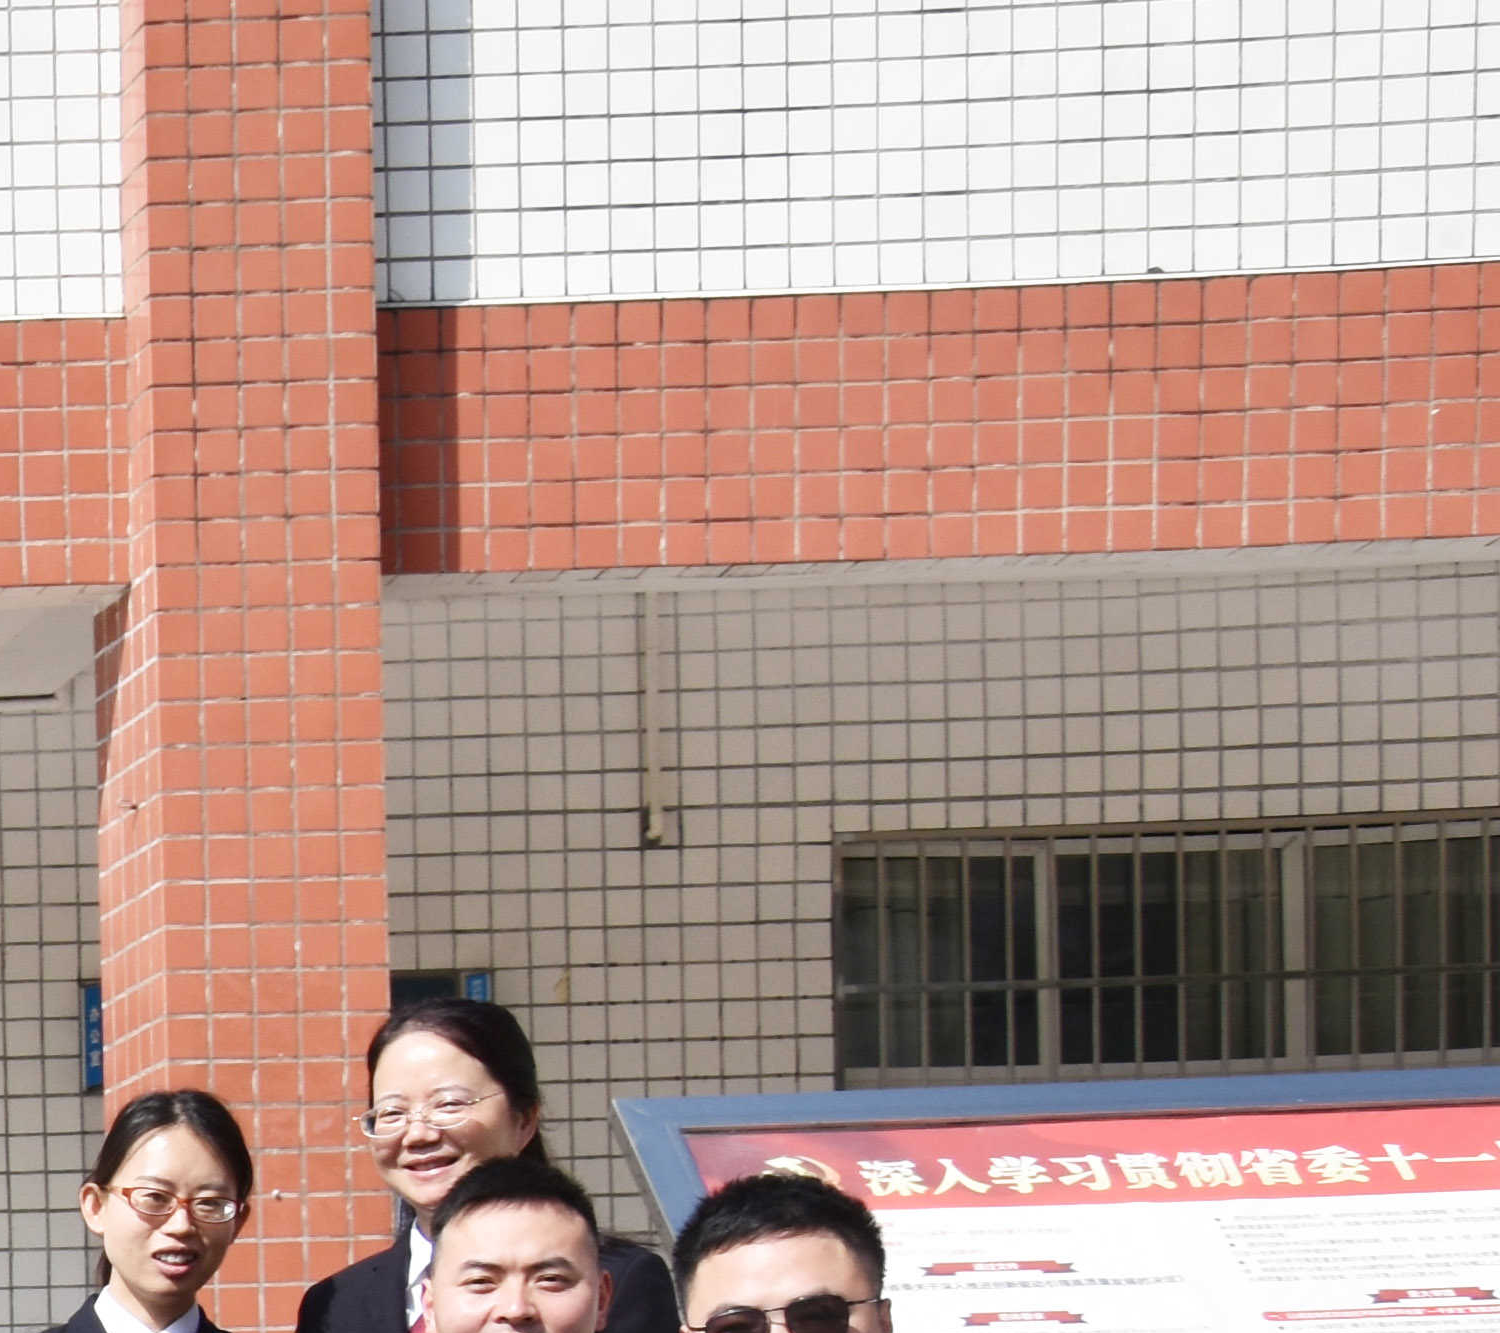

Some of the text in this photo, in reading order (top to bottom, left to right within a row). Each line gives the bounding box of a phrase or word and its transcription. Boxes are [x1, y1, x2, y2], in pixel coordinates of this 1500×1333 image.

[857, 1141, 1500, 1197] 深入学习贯彻省委十一
